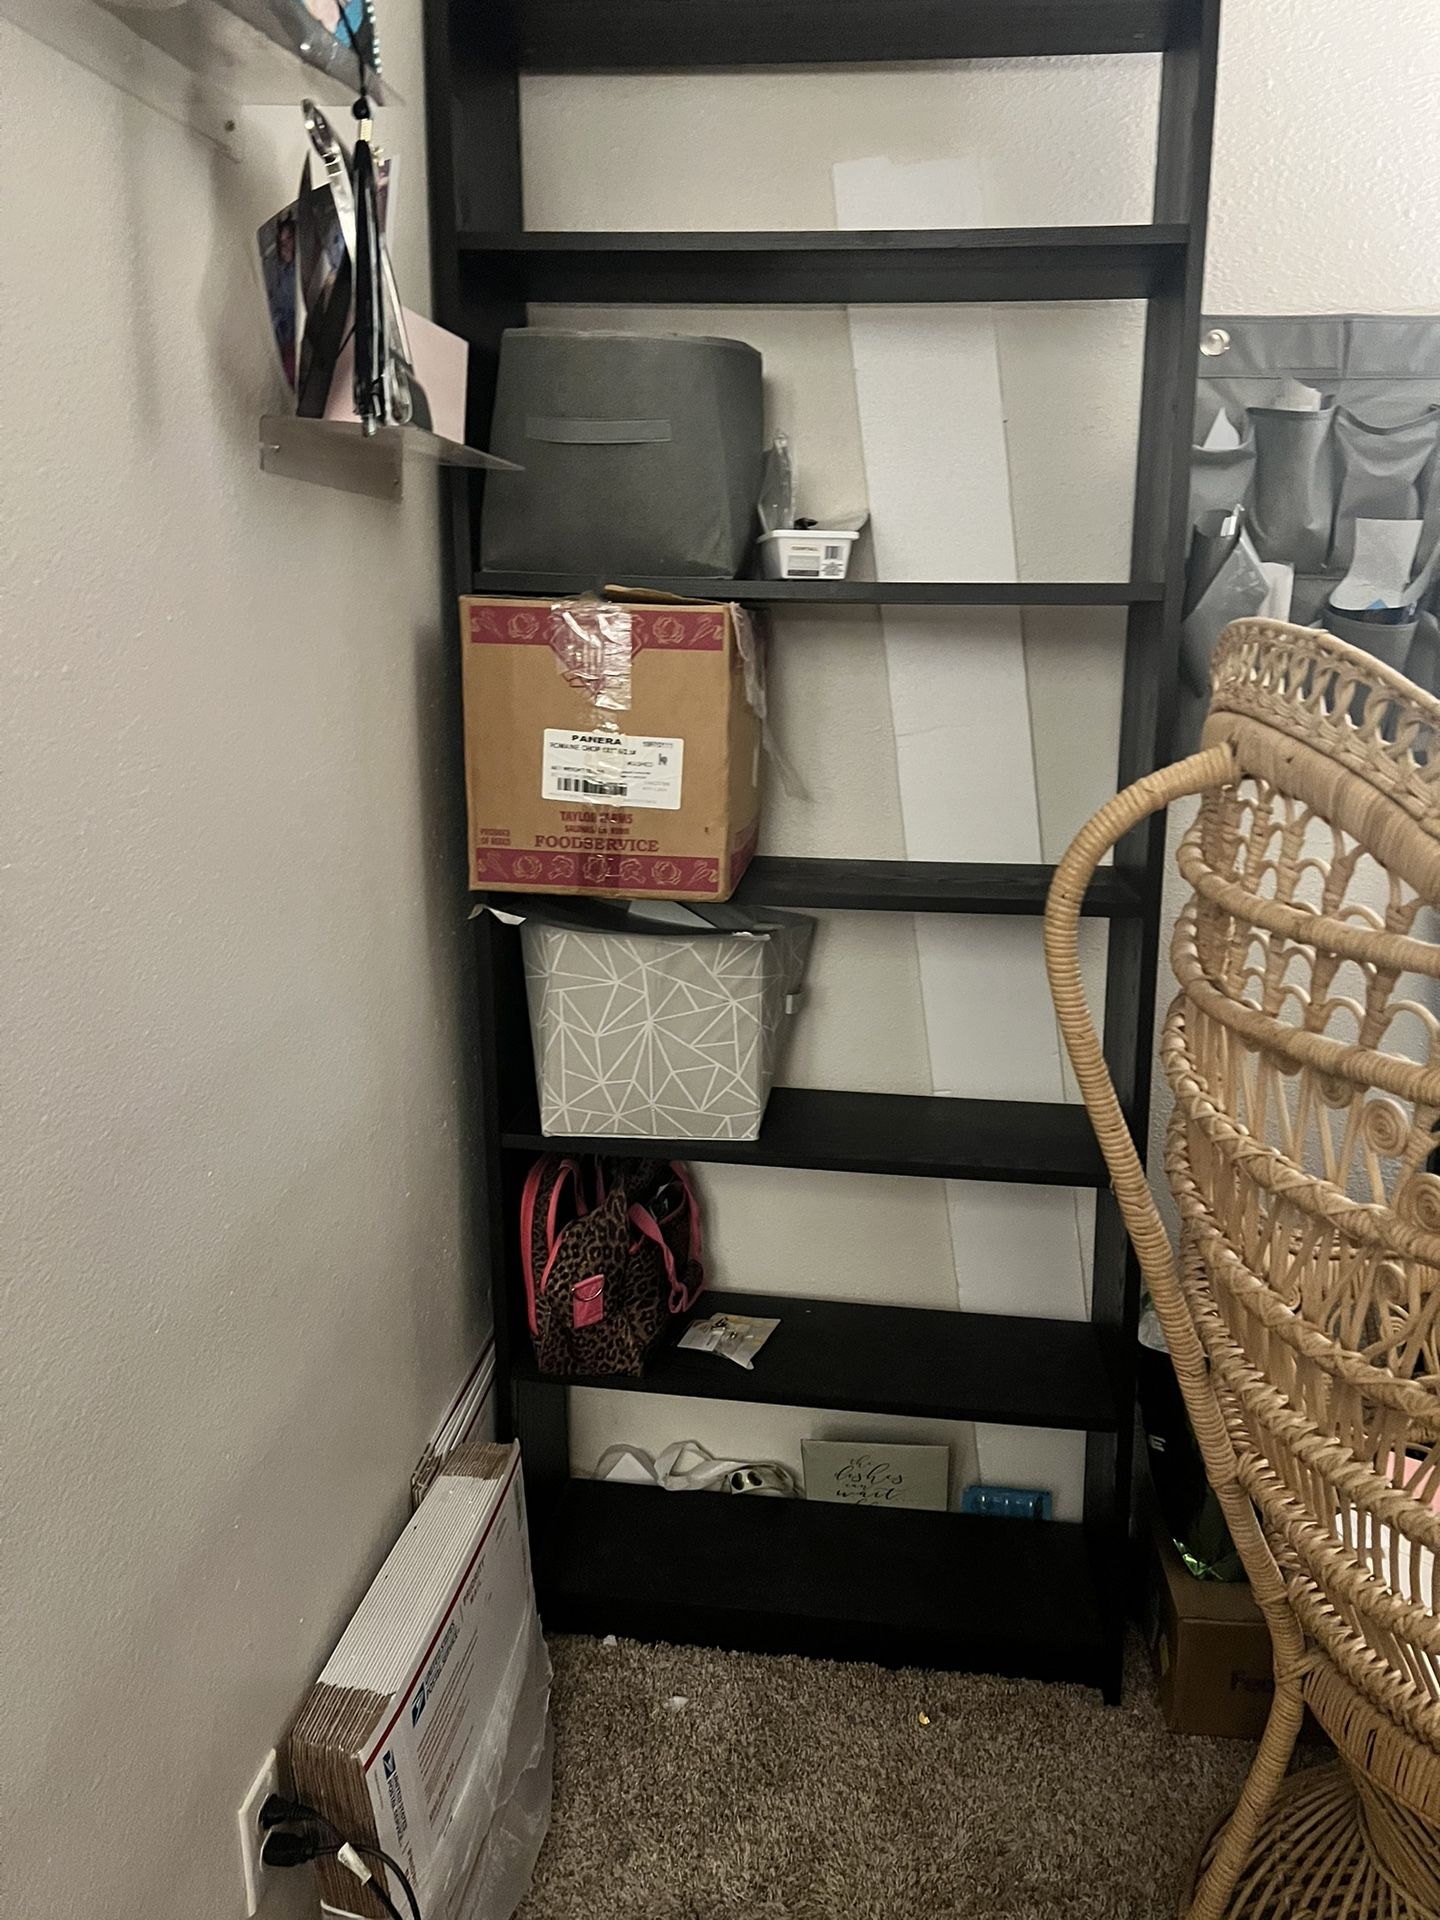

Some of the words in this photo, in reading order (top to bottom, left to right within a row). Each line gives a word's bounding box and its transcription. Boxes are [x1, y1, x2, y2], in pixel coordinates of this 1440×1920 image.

[572, 734, 622, 745] PANERA
[560, 811, 597, 823] TAYLOR
[535, 835, 660, 852] FOODSERVICE
